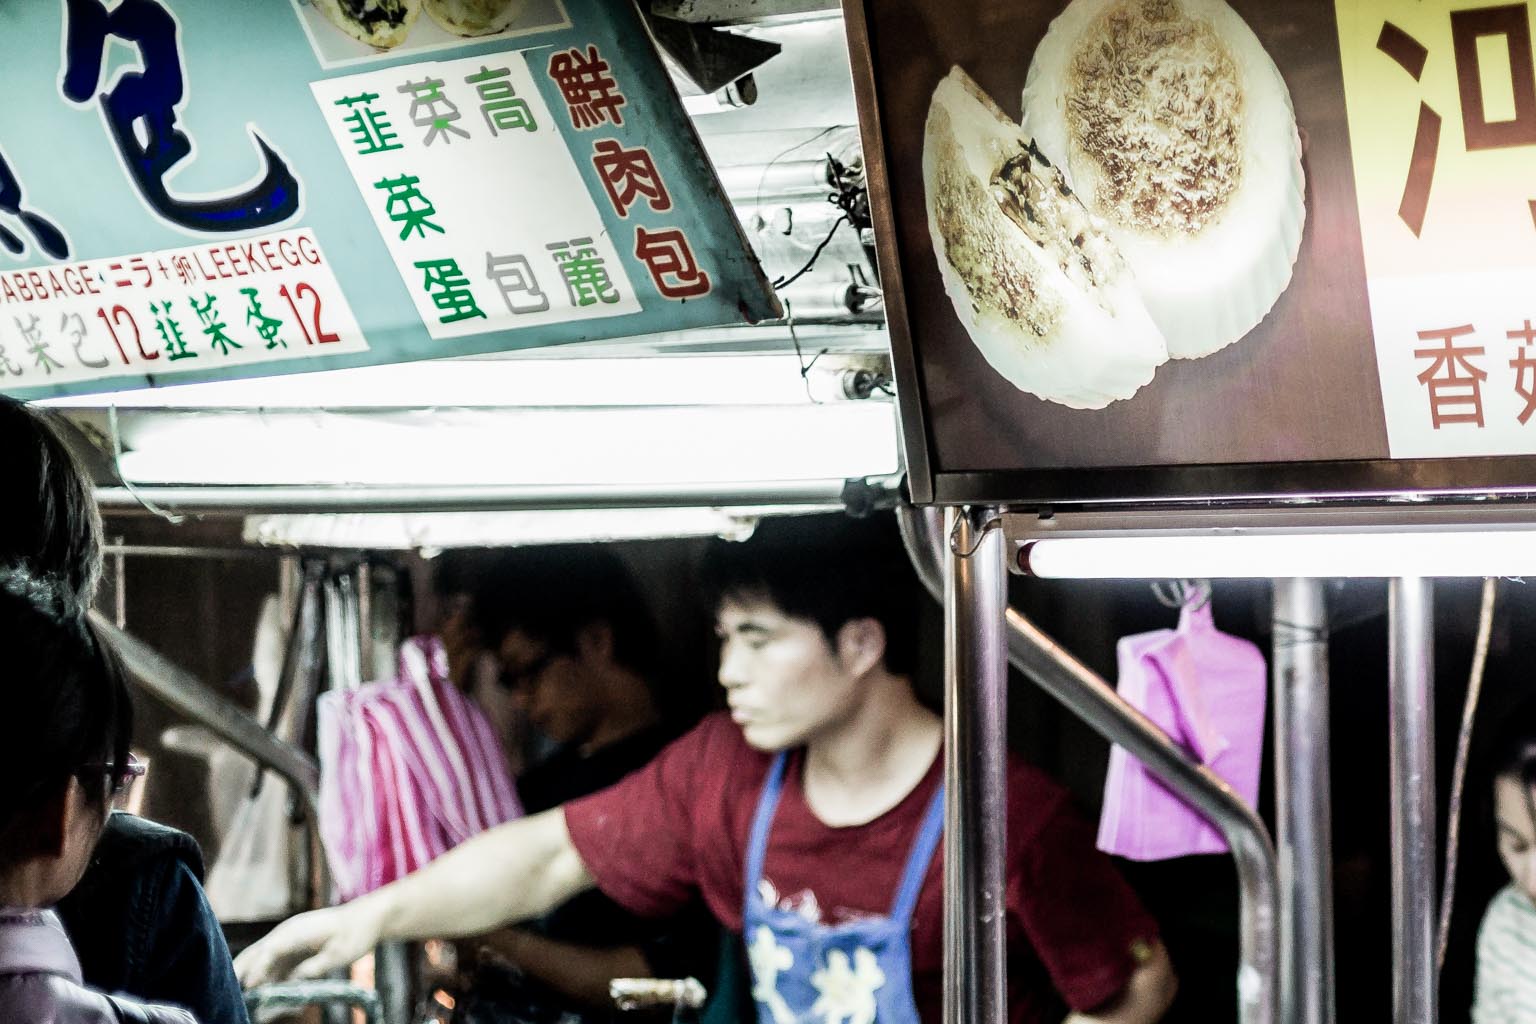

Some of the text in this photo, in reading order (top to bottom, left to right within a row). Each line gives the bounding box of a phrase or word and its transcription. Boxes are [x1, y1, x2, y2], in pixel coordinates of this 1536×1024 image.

[548, 45, 712, 298] 鮮肉包
[0, 265, 100, 303] ABBAGE
[97, 303, 159, 364] 12
[279, 282, 341, 345] 12
